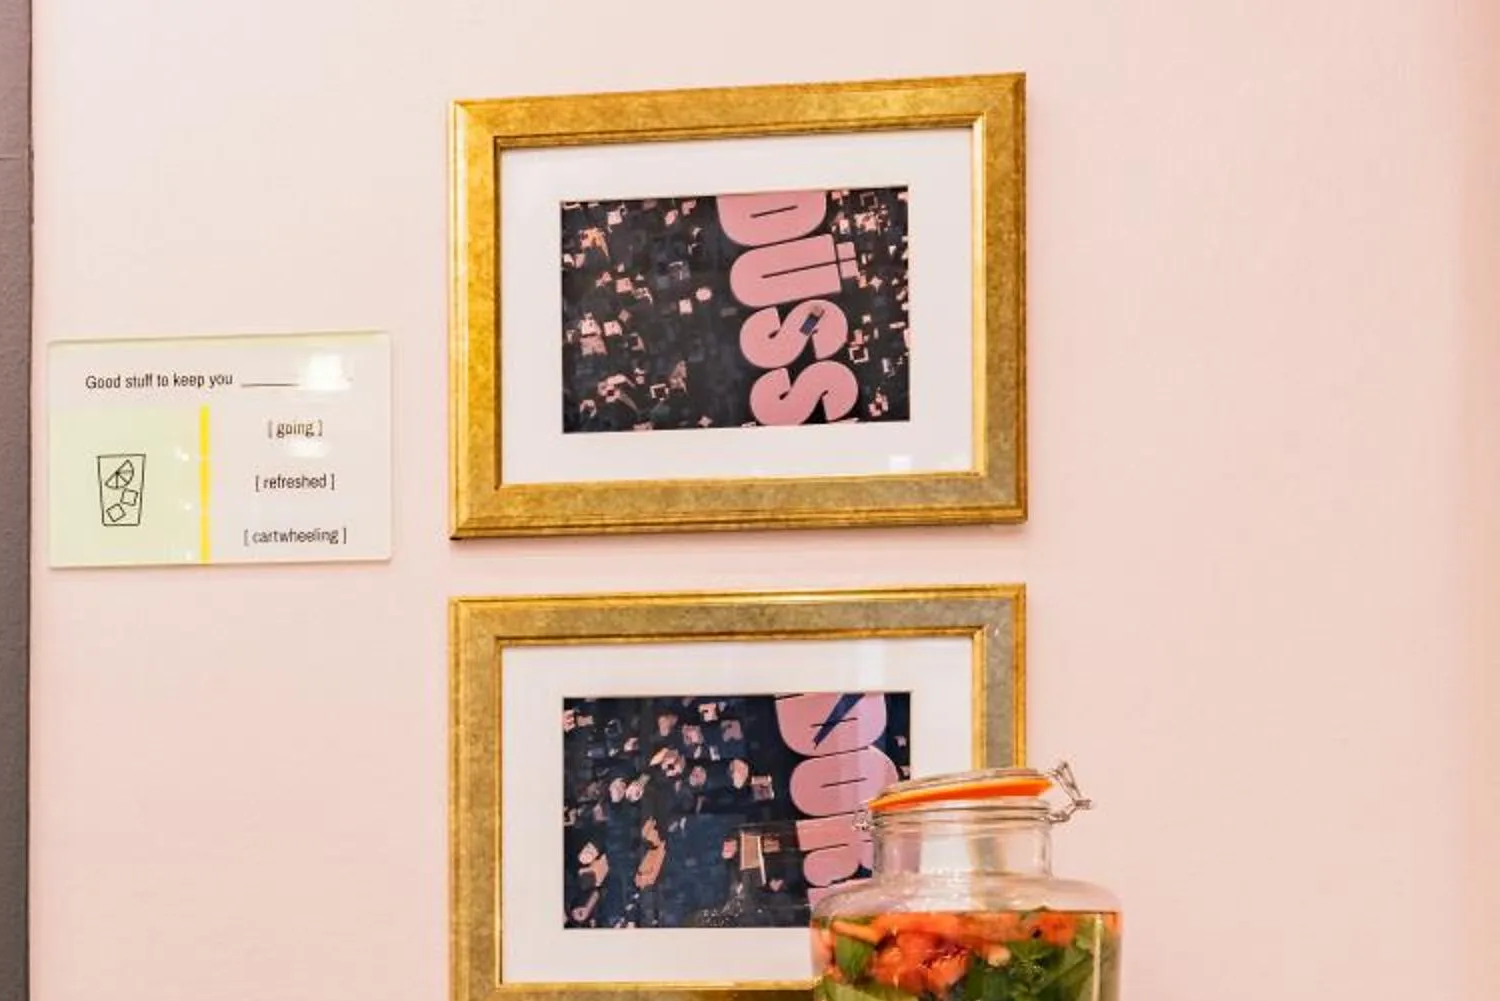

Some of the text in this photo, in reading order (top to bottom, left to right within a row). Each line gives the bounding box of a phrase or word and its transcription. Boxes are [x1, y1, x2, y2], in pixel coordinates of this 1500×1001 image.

[85, 372, 233, 389] Good stuff to keep you
[275, 423, 315, 438] going
[263, 473, 326, 489] refreshed
[252, 528, 339, 544] cartwheeling
